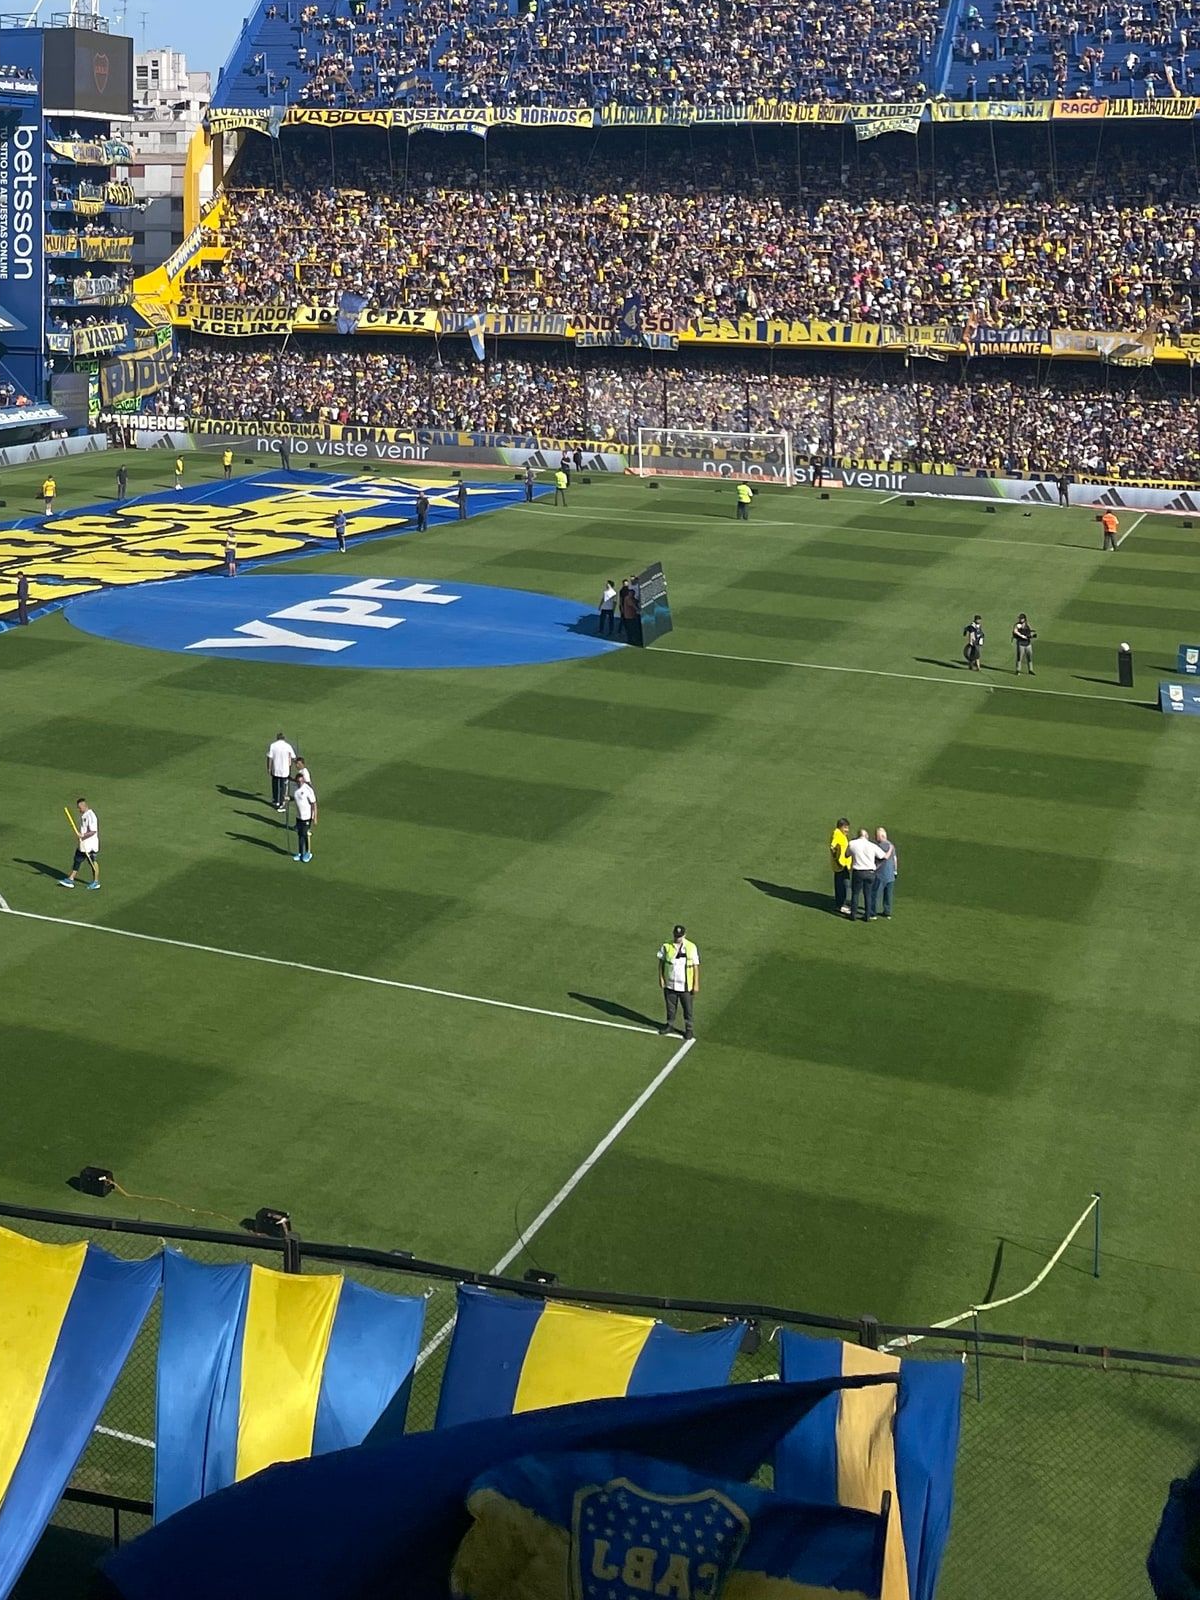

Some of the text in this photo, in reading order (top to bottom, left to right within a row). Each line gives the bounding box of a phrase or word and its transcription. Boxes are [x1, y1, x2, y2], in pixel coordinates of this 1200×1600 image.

[324, 109, 387, 124] BOCA
[393, 107, 487, 127] ENSENADA
[521, 108, 577, 124] HORNOS
[867, 104, 922, 117] MADERO
[1060, 102, 1099, 114] RAGO
[0, 141, 8, 169] SITIO
[0, 171, 8, 185] DE
[13, 125, 38, 280] betsson
[0, 240, 8, 280] ONLINE
[200, 304, 298, 322] LIBERTADOR
[386, 311, 427, 326] PAZ
[700, 317, 758, 340] SAN
[767, 320, 880, 346] MARTIN
[973, 328, 1048, 343] ICTORIA
[980, 342, 1041, 355] DIAMANTE
[290, 437, 309, 454] lo
[316, 440, 368, 458] viste
[375, 443, 430, 460] venir
[842, 467, 908, 490] venir
[184, 578, 463, 652] YPF
